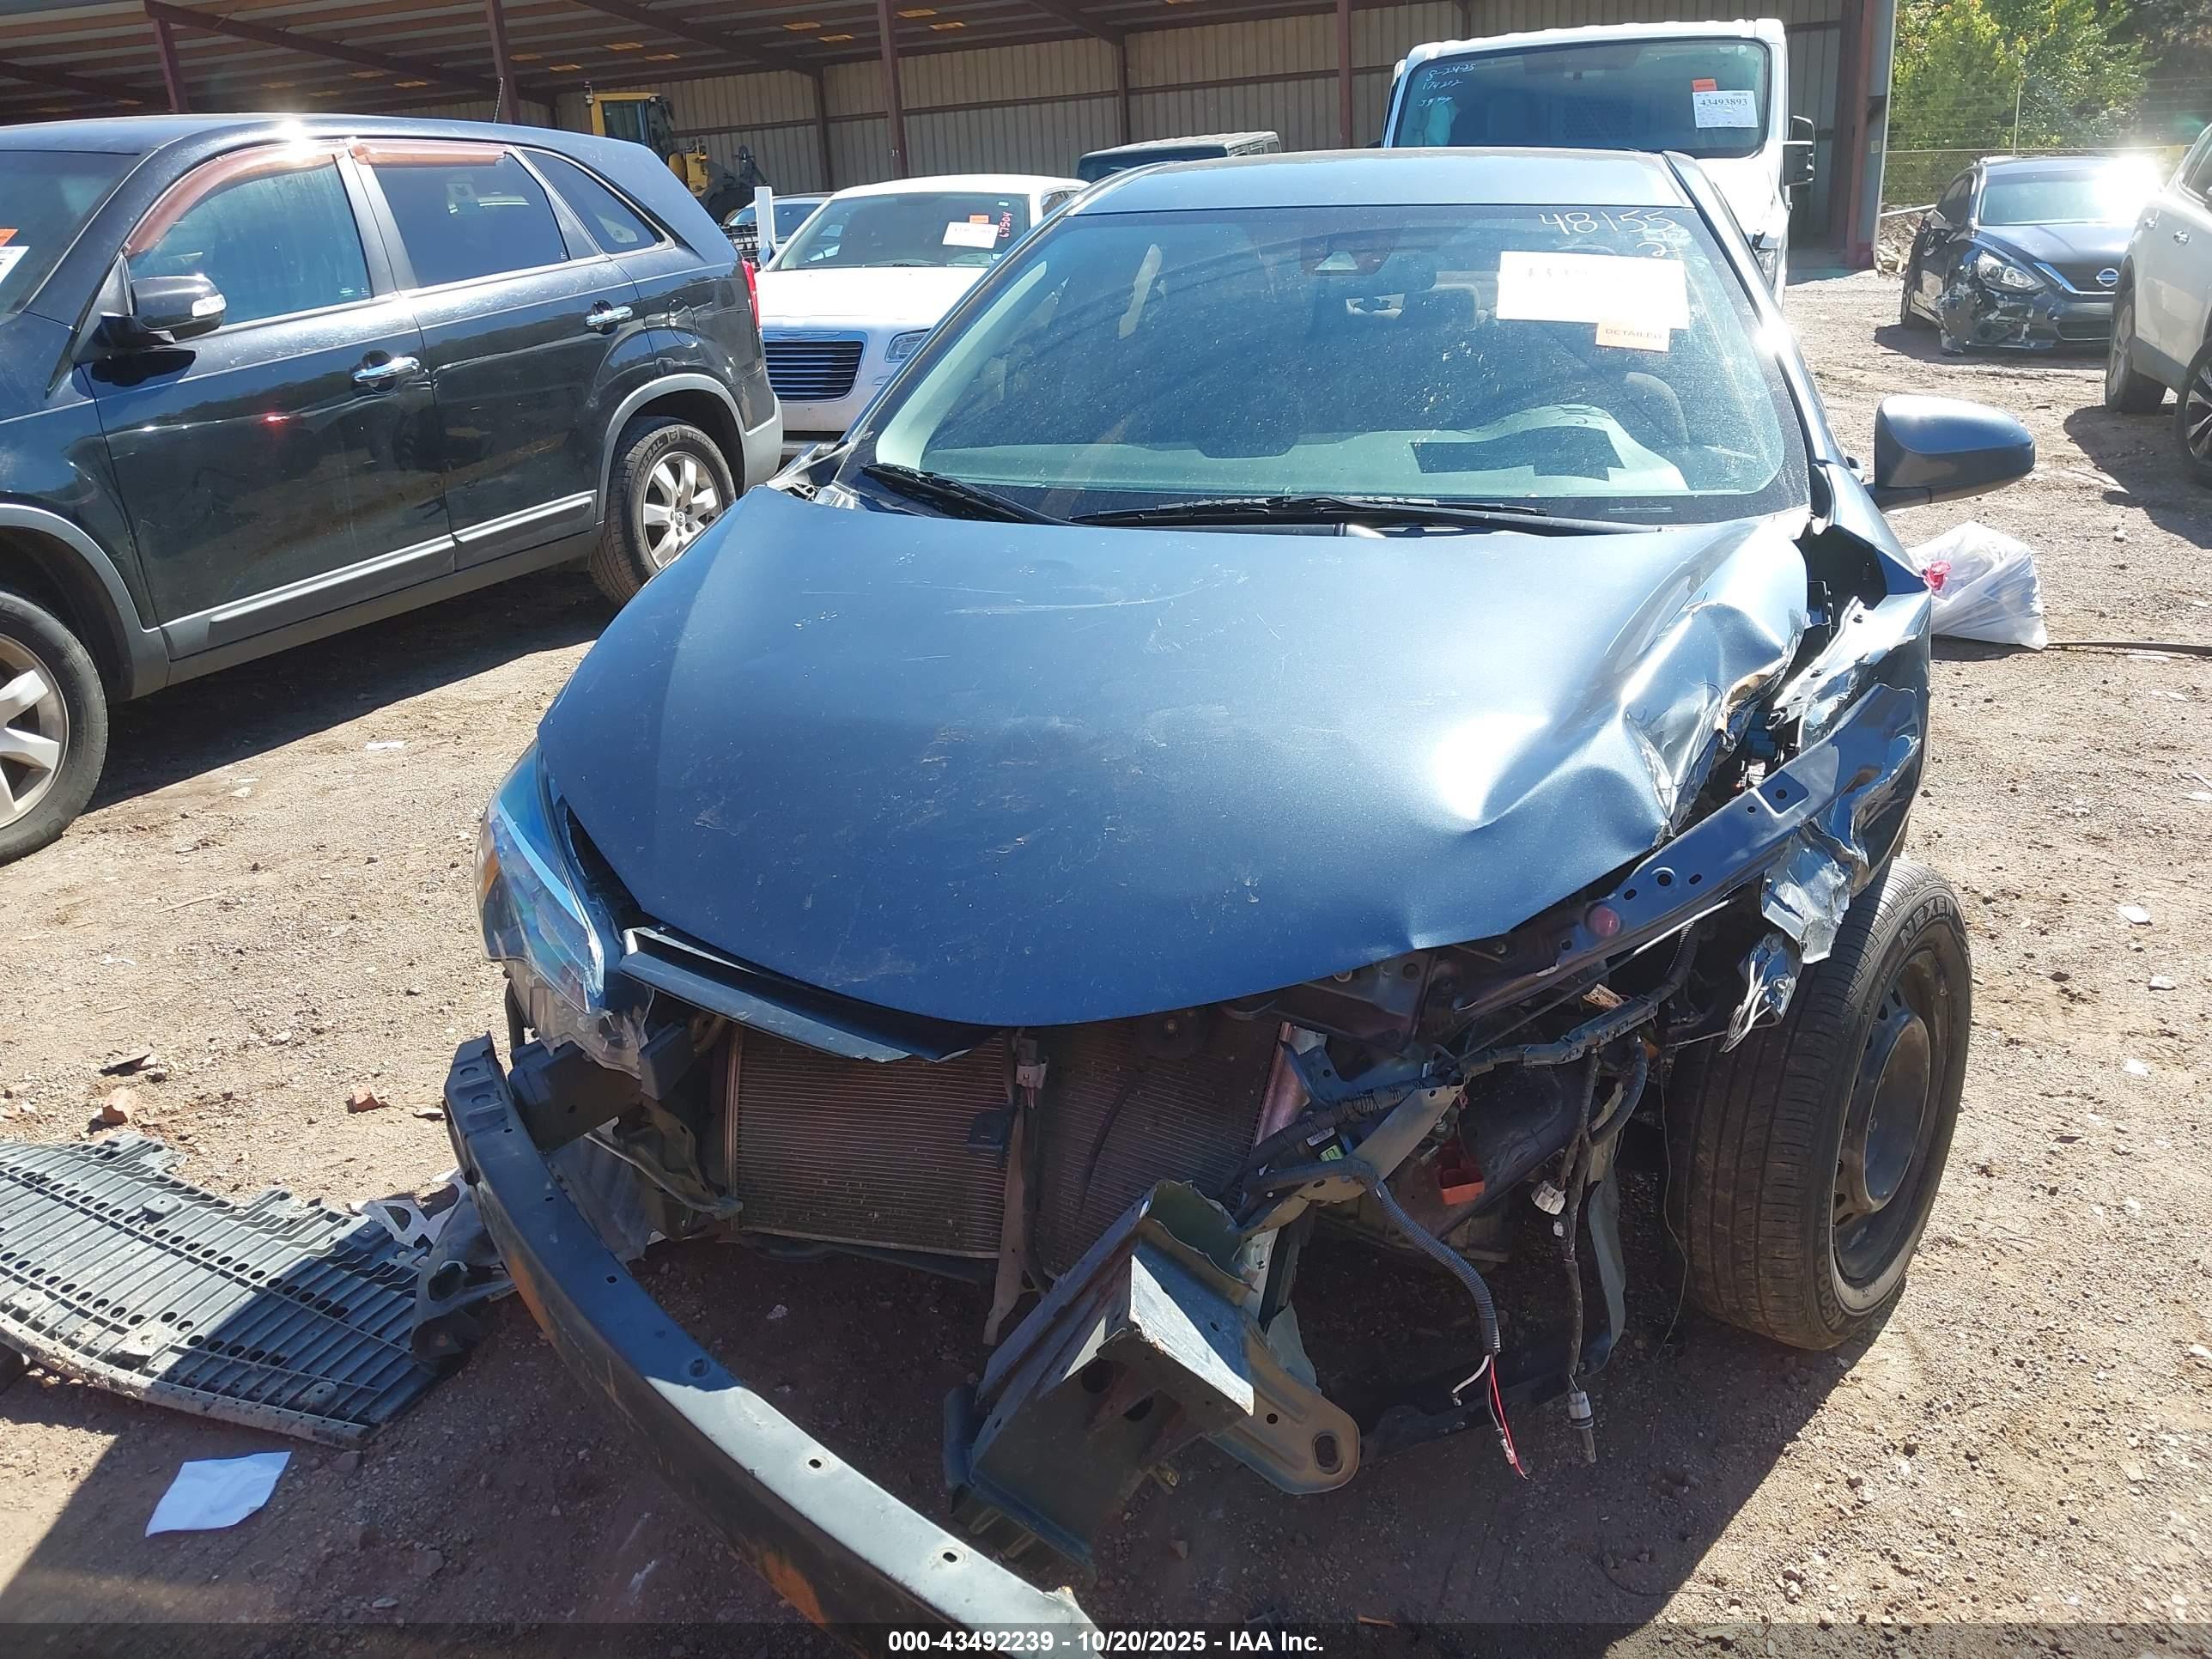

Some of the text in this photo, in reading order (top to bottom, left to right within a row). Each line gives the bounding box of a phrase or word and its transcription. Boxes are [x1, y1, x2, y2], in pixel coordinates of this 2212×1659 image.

[998, 211, 1013, 238] 67504
[1539, 210, 1677, 235] 48155
[1899, 896, 1954, 949] NEXEN
[1816, 1255, 1846, 1330] N5000
